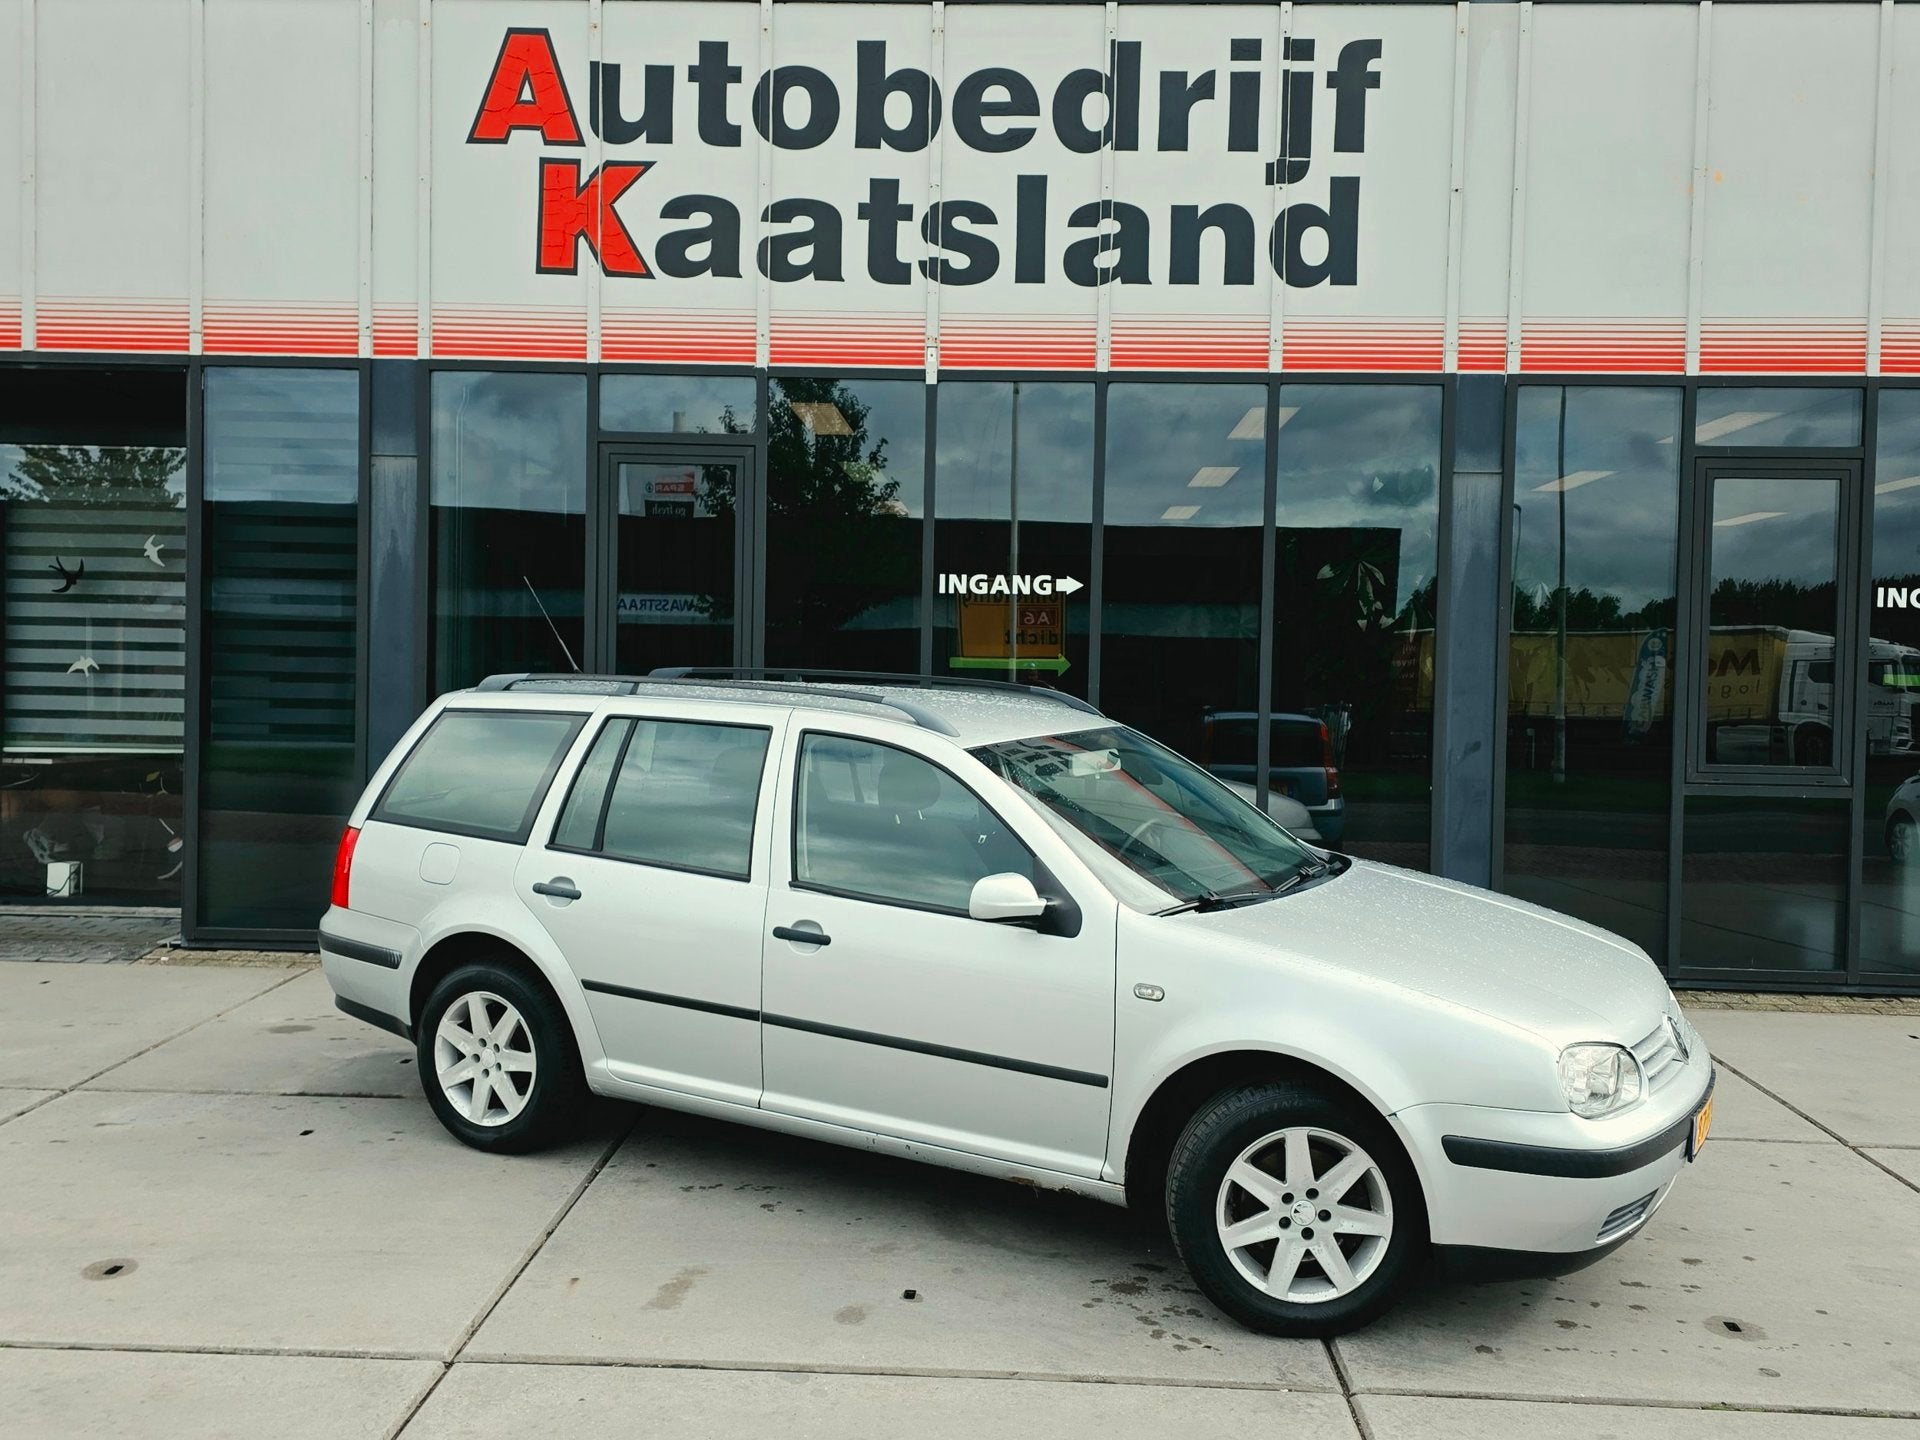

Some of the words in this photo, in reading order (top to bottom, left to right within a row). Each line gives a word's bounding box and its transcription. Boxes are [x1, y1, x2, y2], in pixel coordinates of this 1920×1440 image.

[465, 27, 1383, 186] Autobedrijf
[536, 156, 1361, 288] Kaatsland
[939, 573, 1052, 595] INGANG
